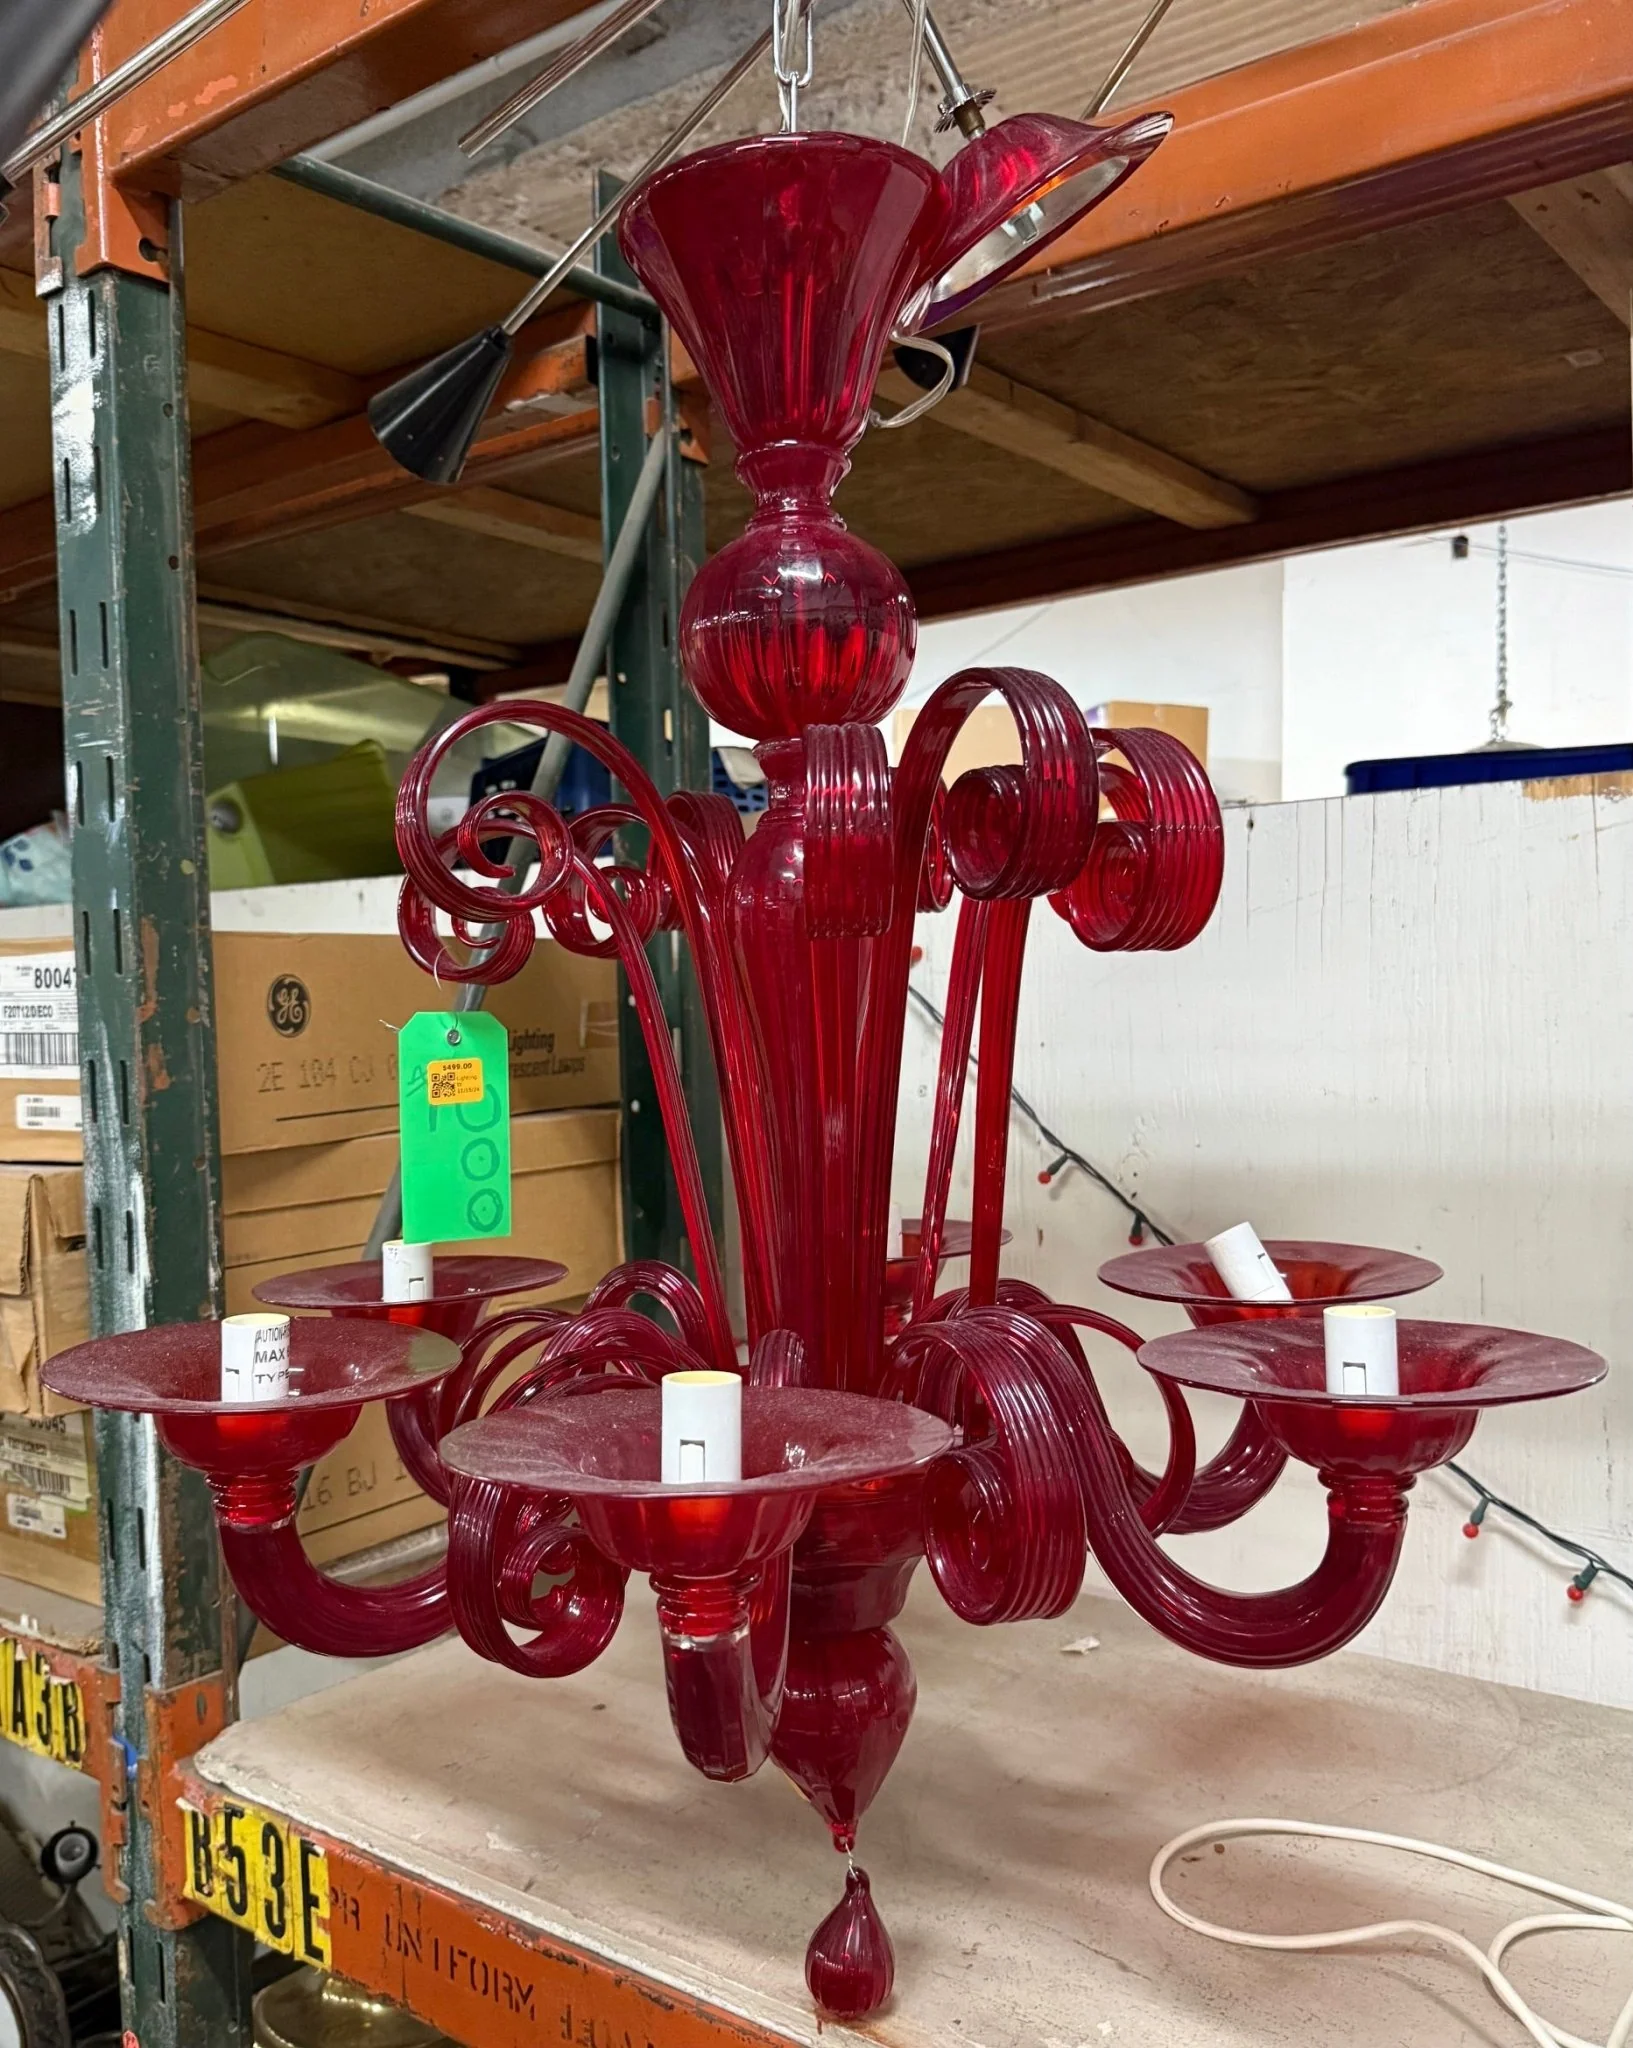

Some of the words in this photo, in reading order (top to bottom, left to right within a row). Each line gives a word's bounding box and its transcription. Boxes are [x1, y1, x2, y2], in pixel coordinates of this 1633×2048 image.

[508, 1028, 555, 1056] ighting
[255, 1060, 286, 1094] 2E
[442, 1062, 473, 1072] $499.00
[254, 1347, 286, 1364] MAX
[254, 1368, 290, 1384] TYPE
[385, 1912, 535, 2022] UNIFORM
